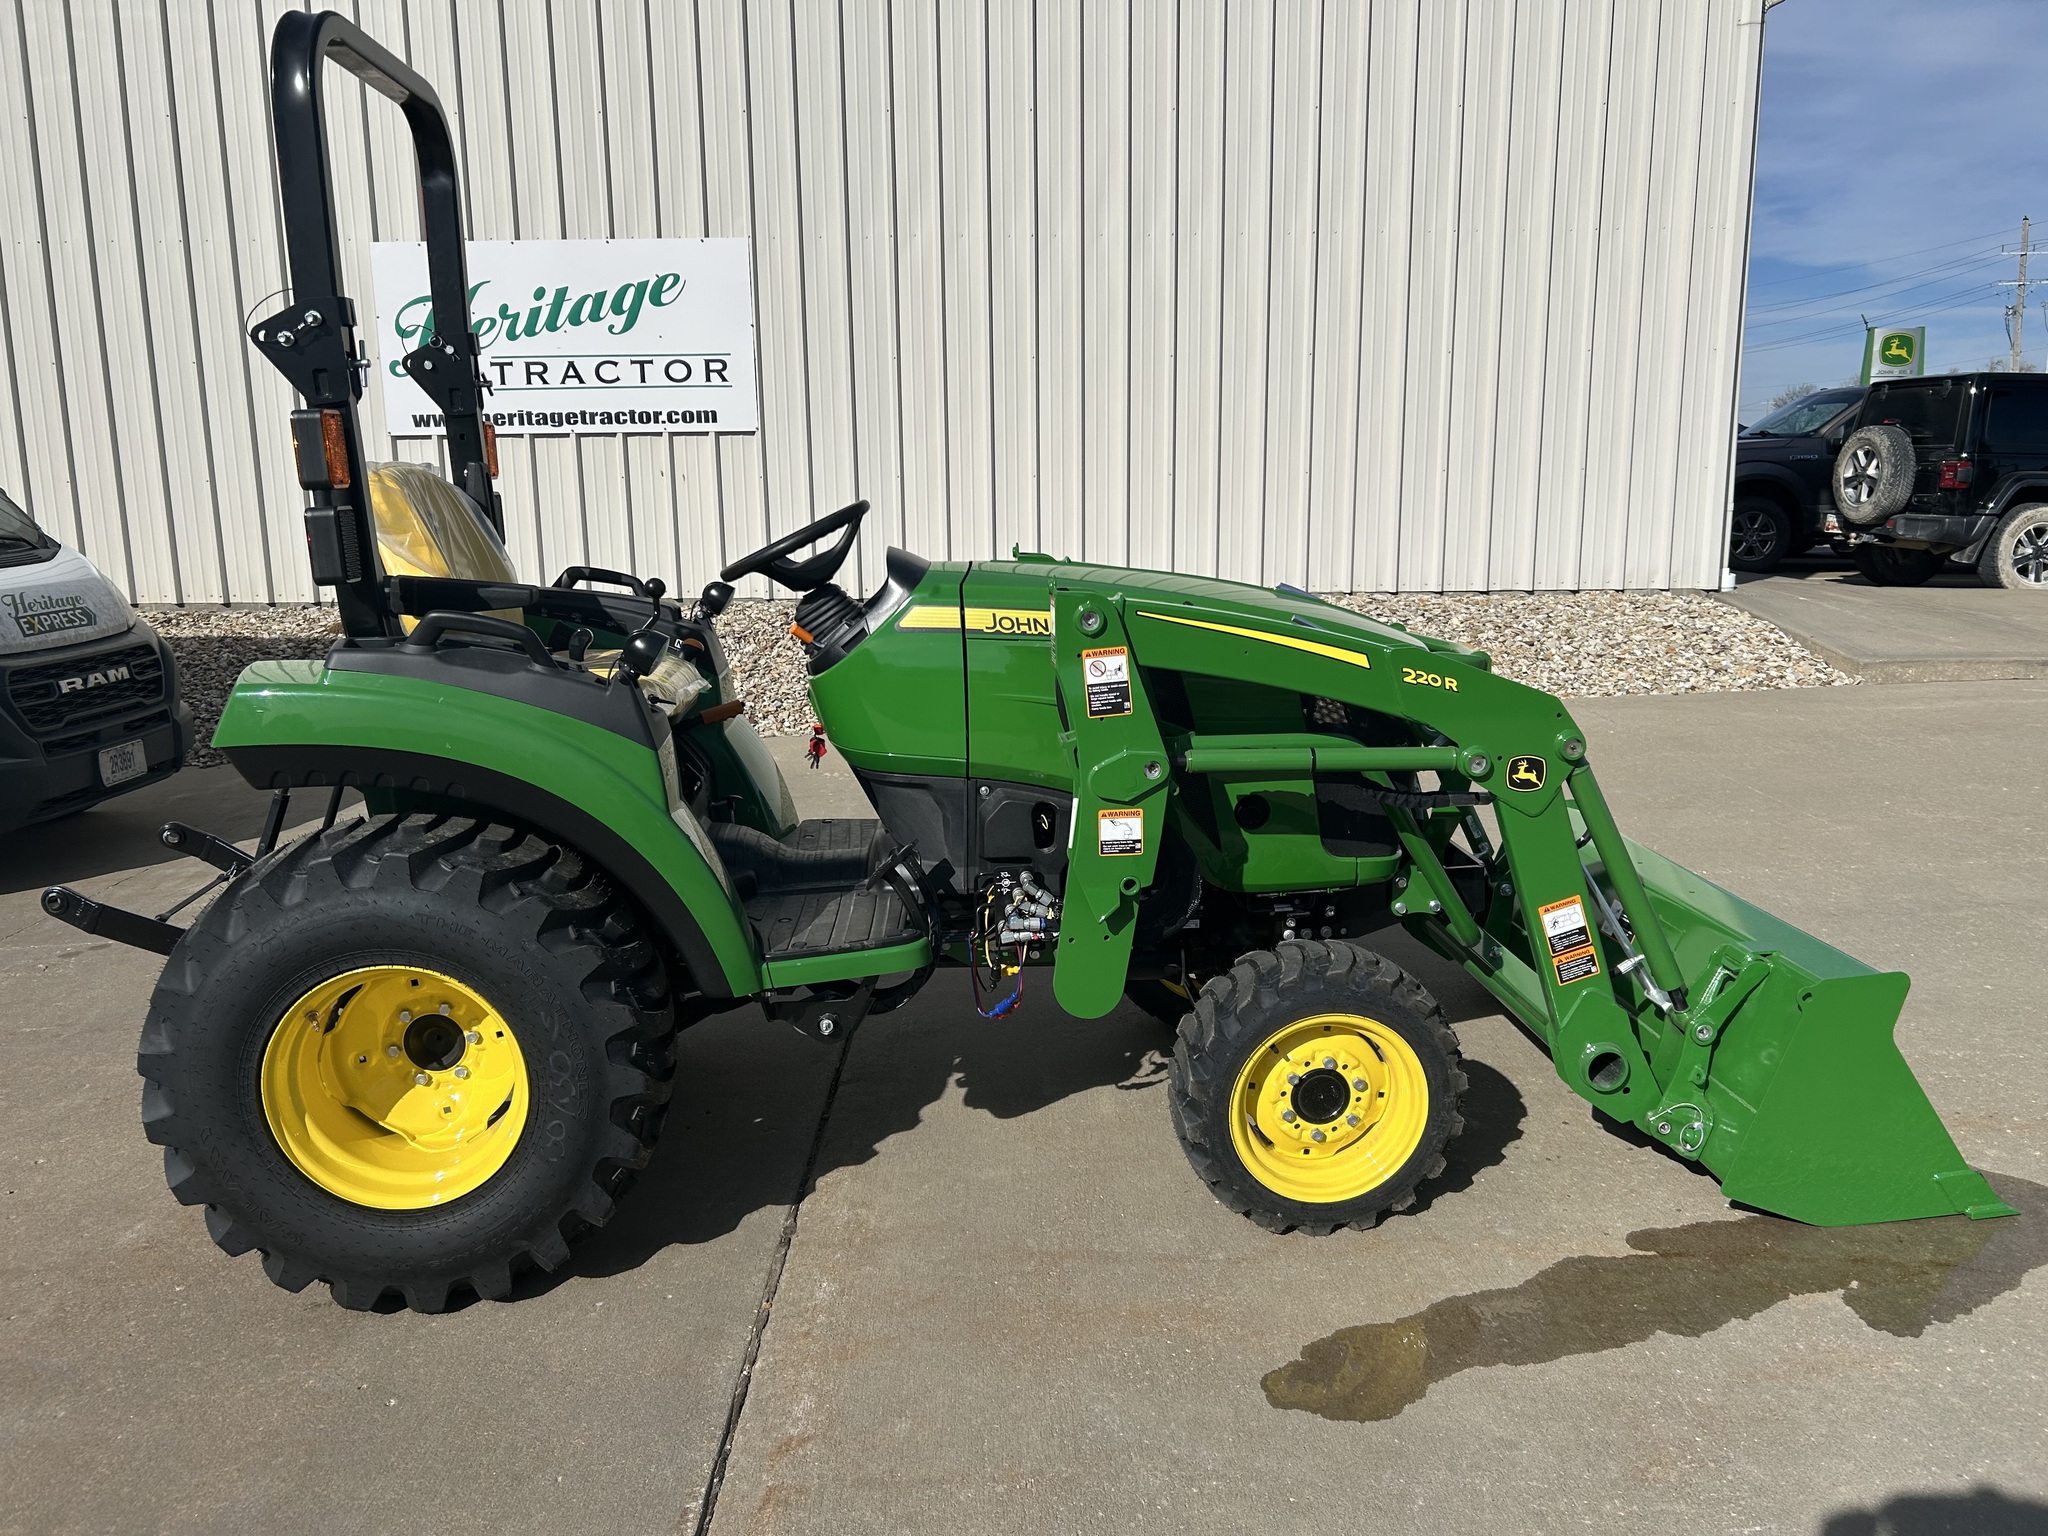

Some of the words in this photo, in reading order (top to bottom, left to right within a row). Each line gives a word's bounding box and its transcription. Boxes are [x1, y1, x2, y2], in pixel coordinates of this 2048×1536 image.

[489, 358, 730, 386] TRACTOR
[412, 409, 718, 429] wweritagetractor.com
[1, 592, 84, 618] Heritage
[19, 610, 88, 634] EXPRESS
[986, 613, 1050, 633] JOHN
[1091, 648, 1126, 657] WARNING
[58, 666, 130, 694] RAM
[1402, 667, 1442, 687] 220
[1444, 676, 1460, 692] R
[1550, 899, 1577, 911] WARNING
[1564, 949, 1591, 961] WARNING
[415, 912, 478, 938] THE
[485, 937, 591, 1121] MARATHONER
